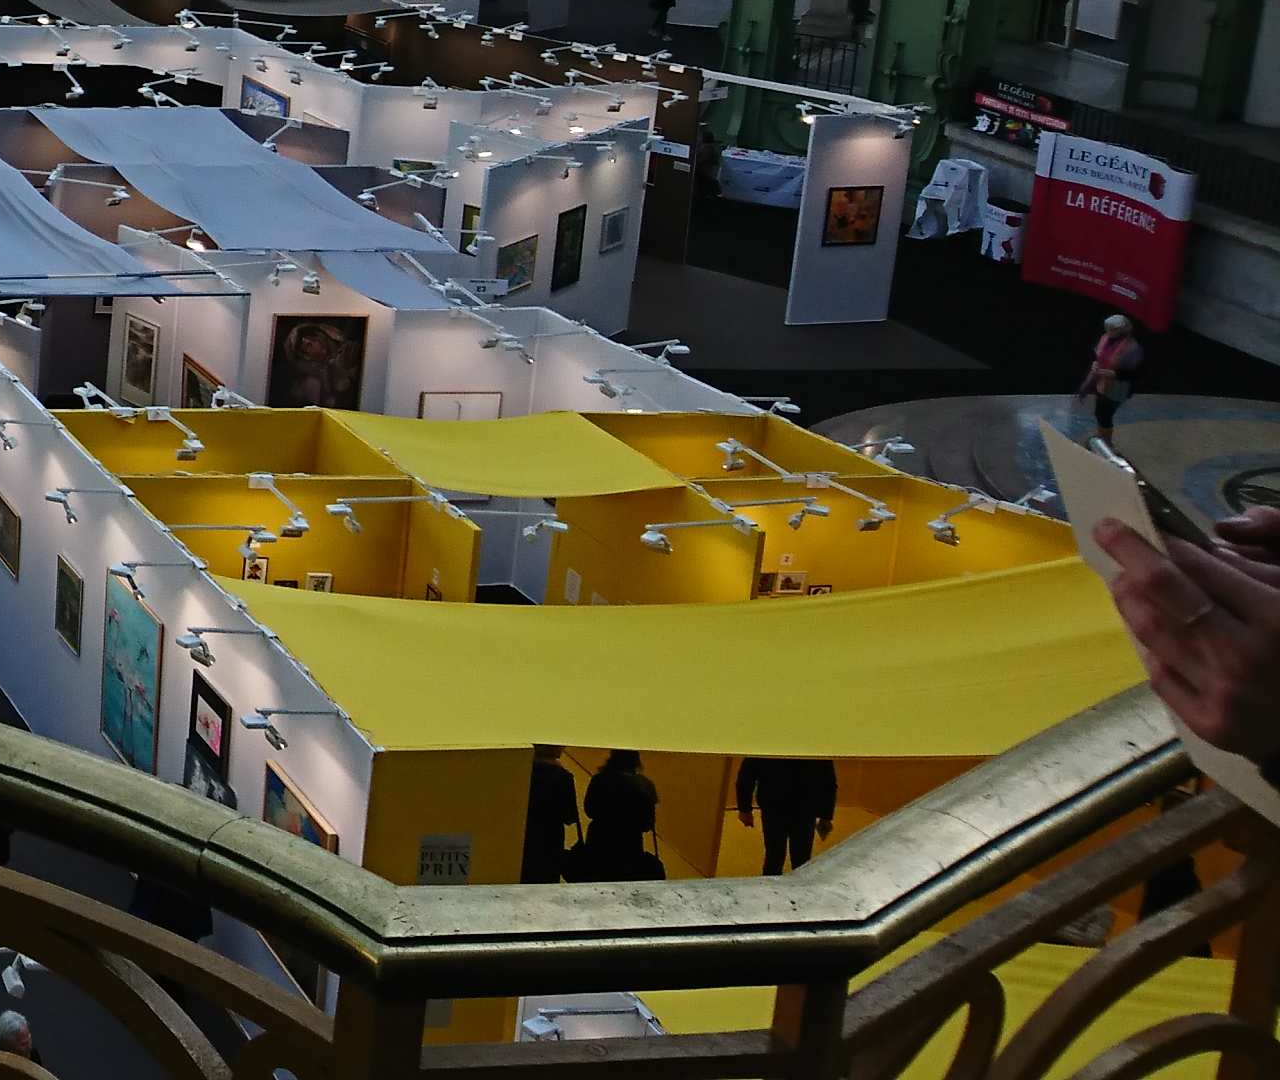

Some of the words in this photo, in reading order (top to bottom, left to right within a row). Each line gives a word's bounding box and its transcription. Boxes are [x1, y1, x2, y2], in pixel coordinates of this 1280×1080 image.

[1065, 164, 1088, 175] DES
[1069, 148, 1092, 163] LE
[1096, 155, 1149, 179] GÉANT
[1066, 190, 1085, 209] LA
[1090, 195, 1157, 234] RÉFÉRENCE
[421, 851, 470, 861] PETITS
[420, 863, 468, 876] PRIX
